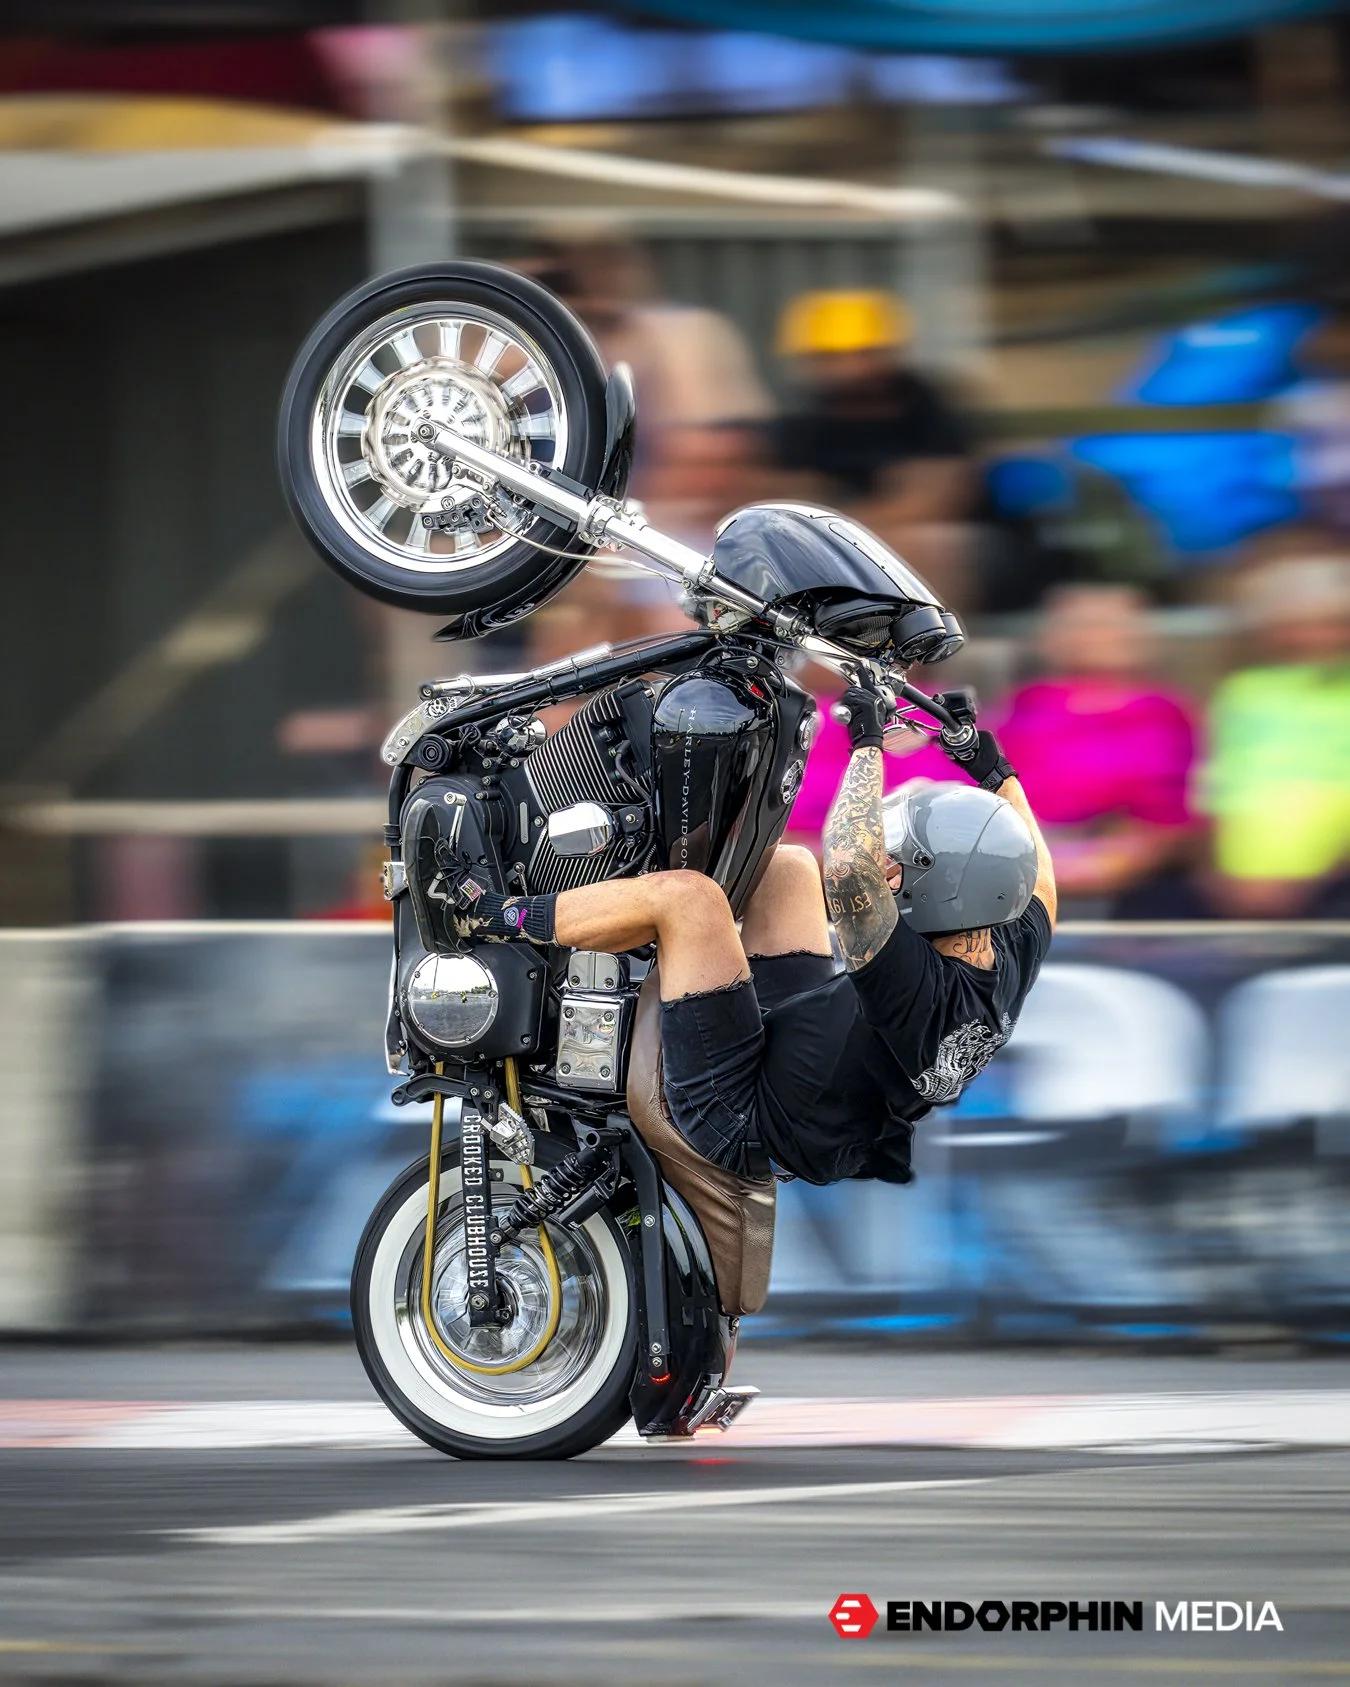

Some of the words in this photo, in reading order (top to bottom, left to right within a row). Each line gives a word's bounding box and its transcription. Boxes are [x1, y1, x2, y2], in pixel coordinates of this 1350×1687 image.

[680, 705, 697, 869] HARLEY-DAVIDSON
[462, 1114, 483, 1186] CROOKED
[465, 1194, 489, 1288] CLUBHOUSE
